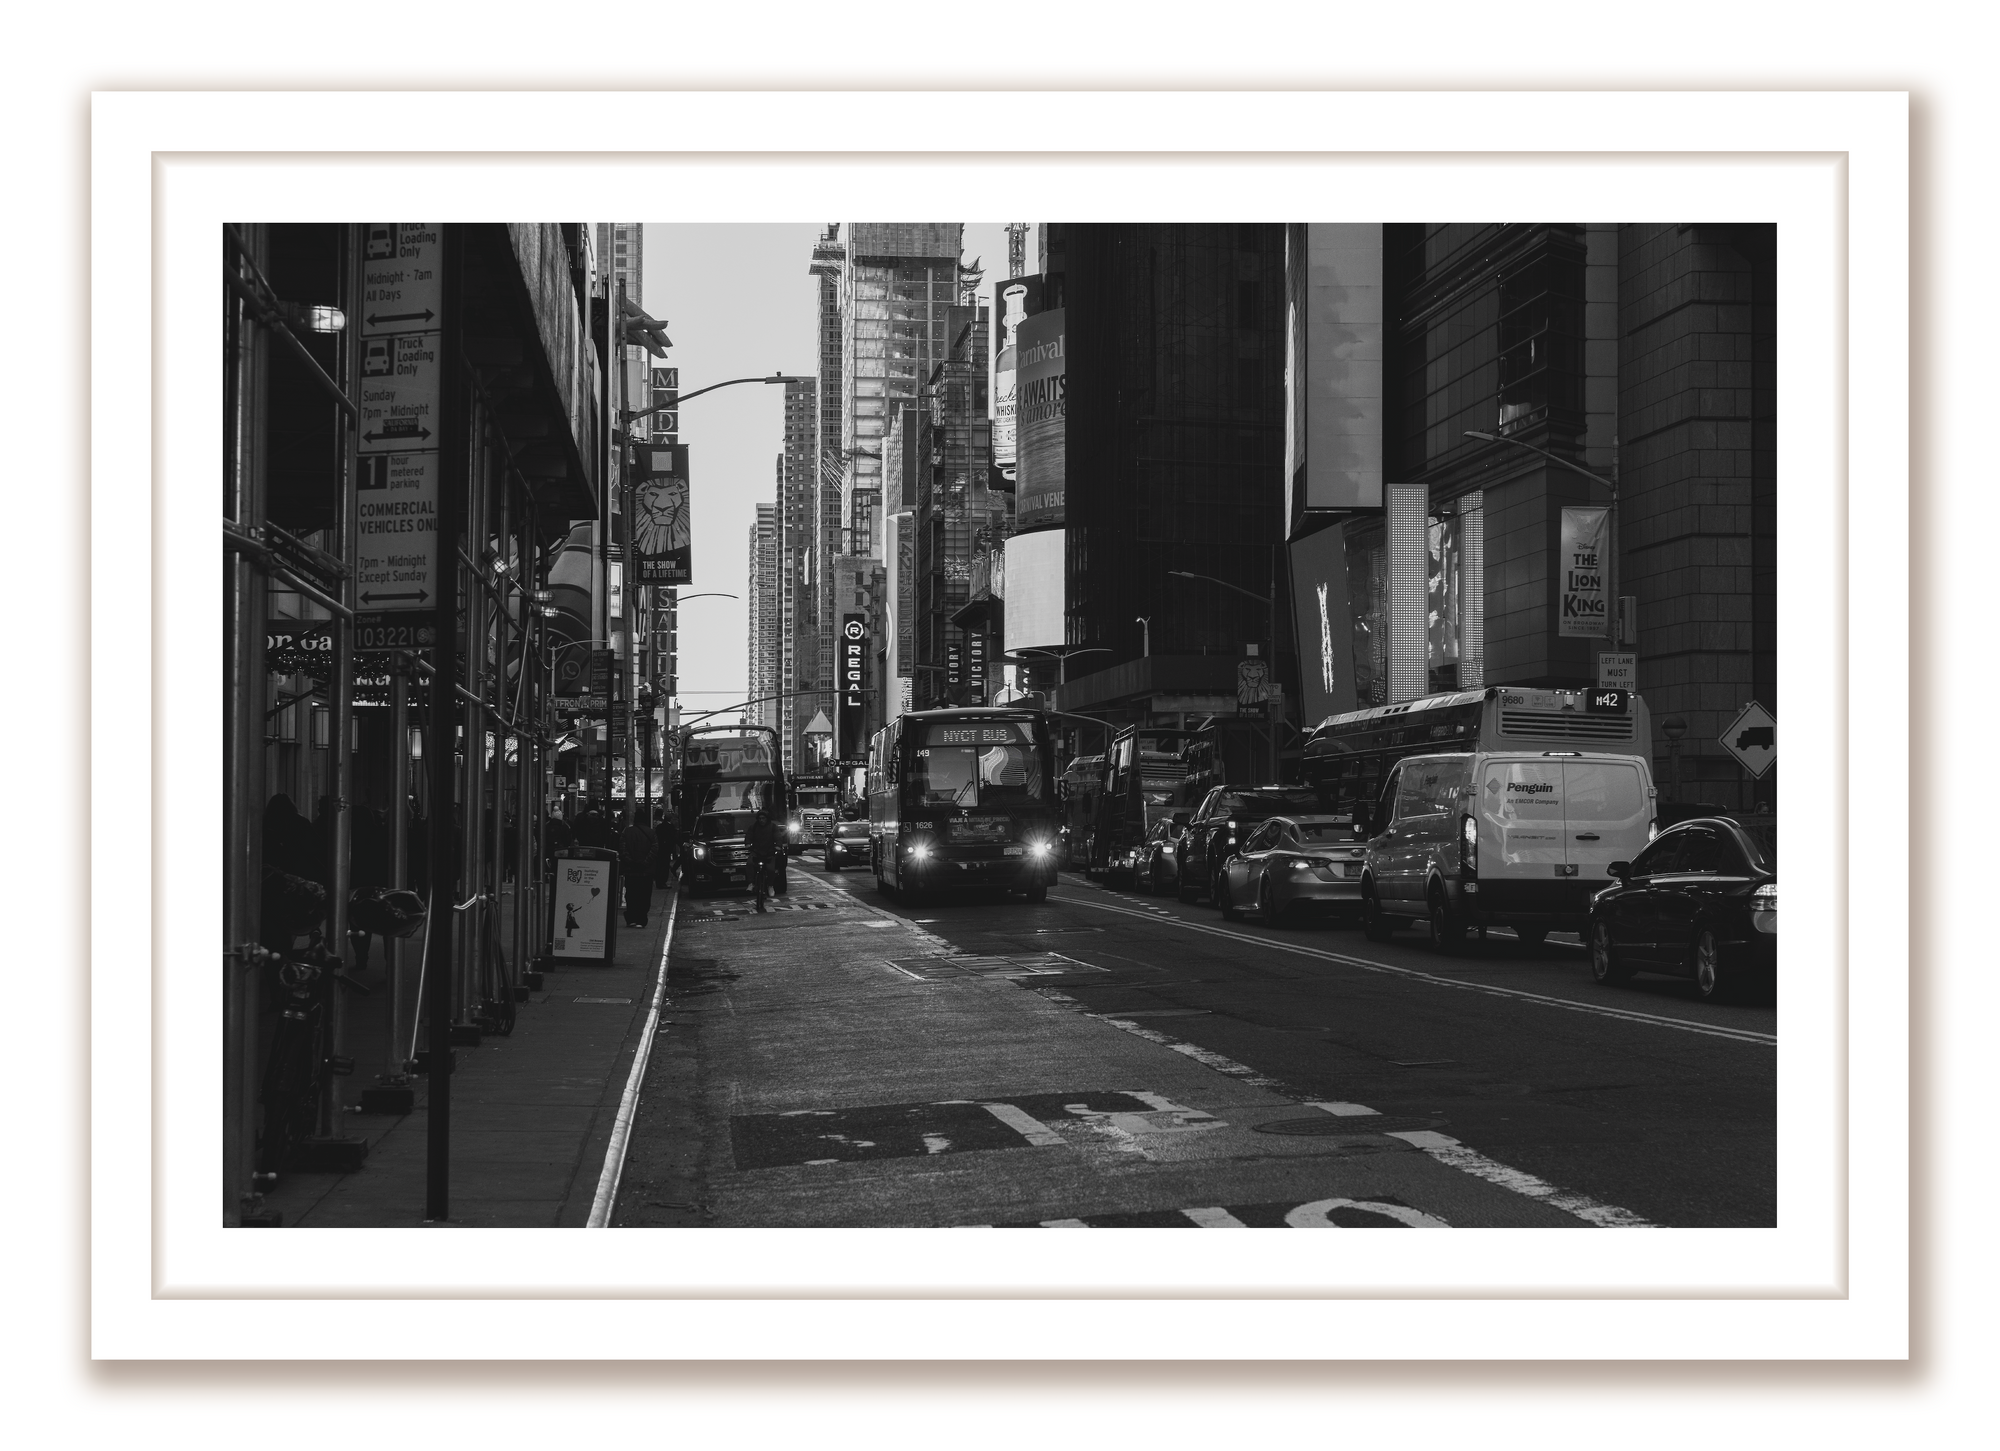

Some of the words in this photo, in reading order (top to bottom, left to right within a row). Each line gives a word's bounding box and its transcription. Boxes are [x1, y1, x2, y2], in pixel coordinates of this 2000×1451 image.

[401, 223, 426, 231] Truck
[400, 231, 437, 245] Loading
[400, 245, 421, 258] Only
[366, 271, 404, 286] Midnight
[413, 269, 432, 281] 7am
[366, 291, 377, 302] All
[379, 289, 402, 303] Days
[397, 338, 424, 350] Truck
[397, 350, 434, 363] Loading
[397, 363, 418, 377] Only
[363, 390, 396, 403] Sunday
[1024, 374, 1066, 409] AWAITS
[362, 407, 382, 420] 7pm
[390, 403, 429, 418] Midnight
[390, 455, 409, 466] hour
[367, 457, 376, 486] 1
[390, 466, 425, 477] metered
[390, 478, 420, 491] parking
[360, 501, 435, 517] COMMERCIAL
[360, 519, 413, 534] VEHICLES
[417, 518, 438, 531] ONL
[1576, 542, 1596, 552] Disney
[359, 556, 379, 570] 7pm
[387, 554, 427, 569] Midnight
[642, 561, 655, 570] THE
[657, 561, 676, 570] SHOW
[1572, 554, 1598, 566] THE
[359, 571, 390, 584] Except
[392, 570, 427, 583] Sunday
[642, 570, 651, 578] OF
[653, 569, 657, 578] A
[658, 569, 687, 578] LIFETIME
[1568, 571, 1601, 592] LION
[1563, 594, 1605, 618] KING
[356, 615, 382, 624] Zone#
[357, 626, 414, 647] 103221
[948, 646, 959, 683] CTORY
[971, 632, 982, 687] VICTORY
[847, 645, 861, 706] REGAL
[1607, 669, 1628, 677] MUST
[590, 699, 608, 708] PRIM
[1502, 695, 1524, 705] 9680
[1595, 693, 1619, 706] M42
[943, 730, 977, 742] NYCT
[983, 730, 1008, 741] BUS
[917, 749, 930, 757] 149
[1507, 782, 1553, 795] Penguin
[915, 821, 933, 829] 1626
